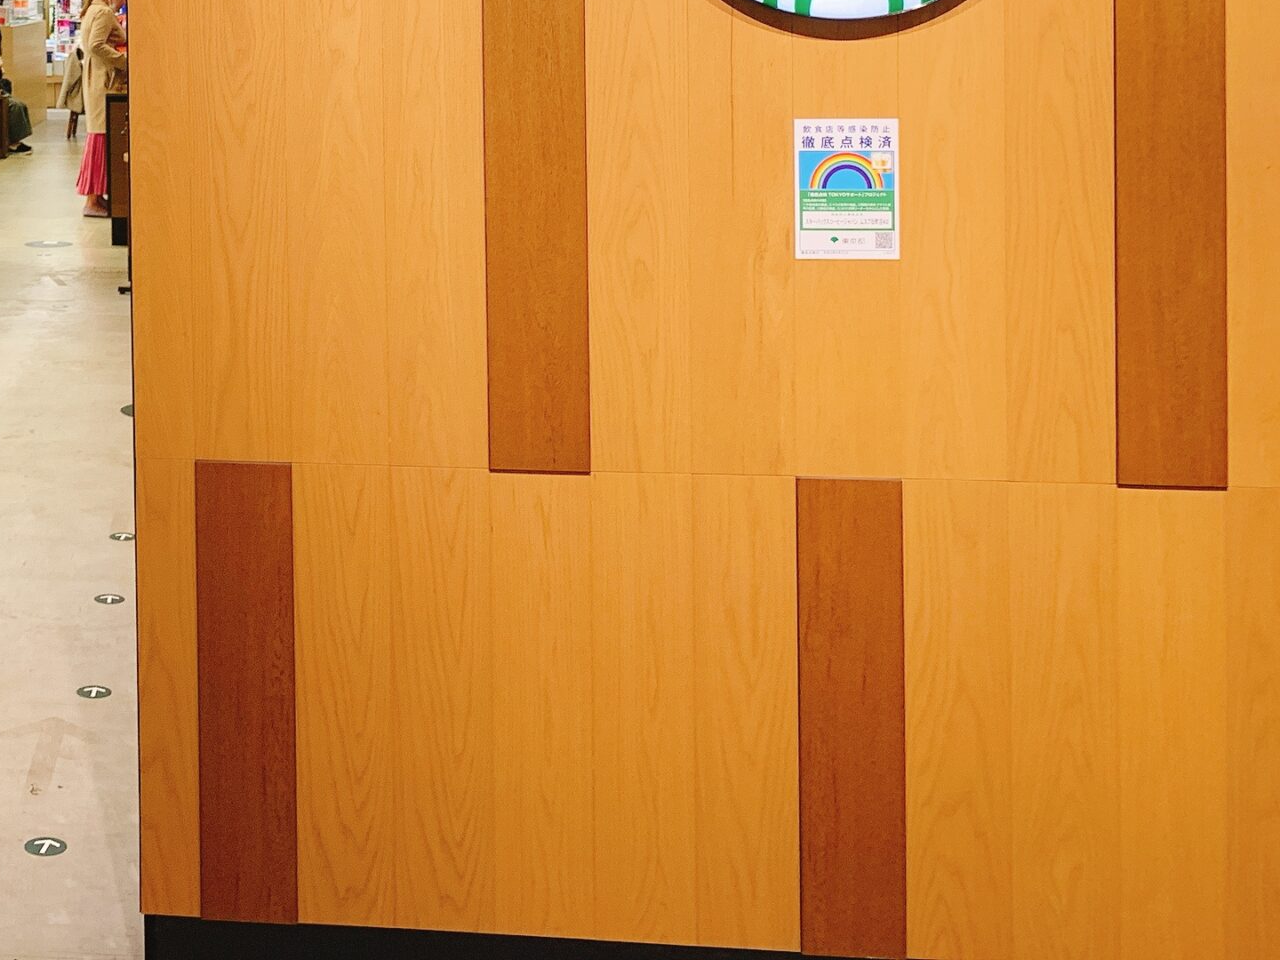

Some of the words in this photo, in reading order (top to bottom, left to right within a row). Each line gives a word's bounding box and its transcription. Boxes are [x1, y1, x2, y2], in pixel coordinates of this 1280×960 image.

[802, 136, 892, 149] 徹底点検済
